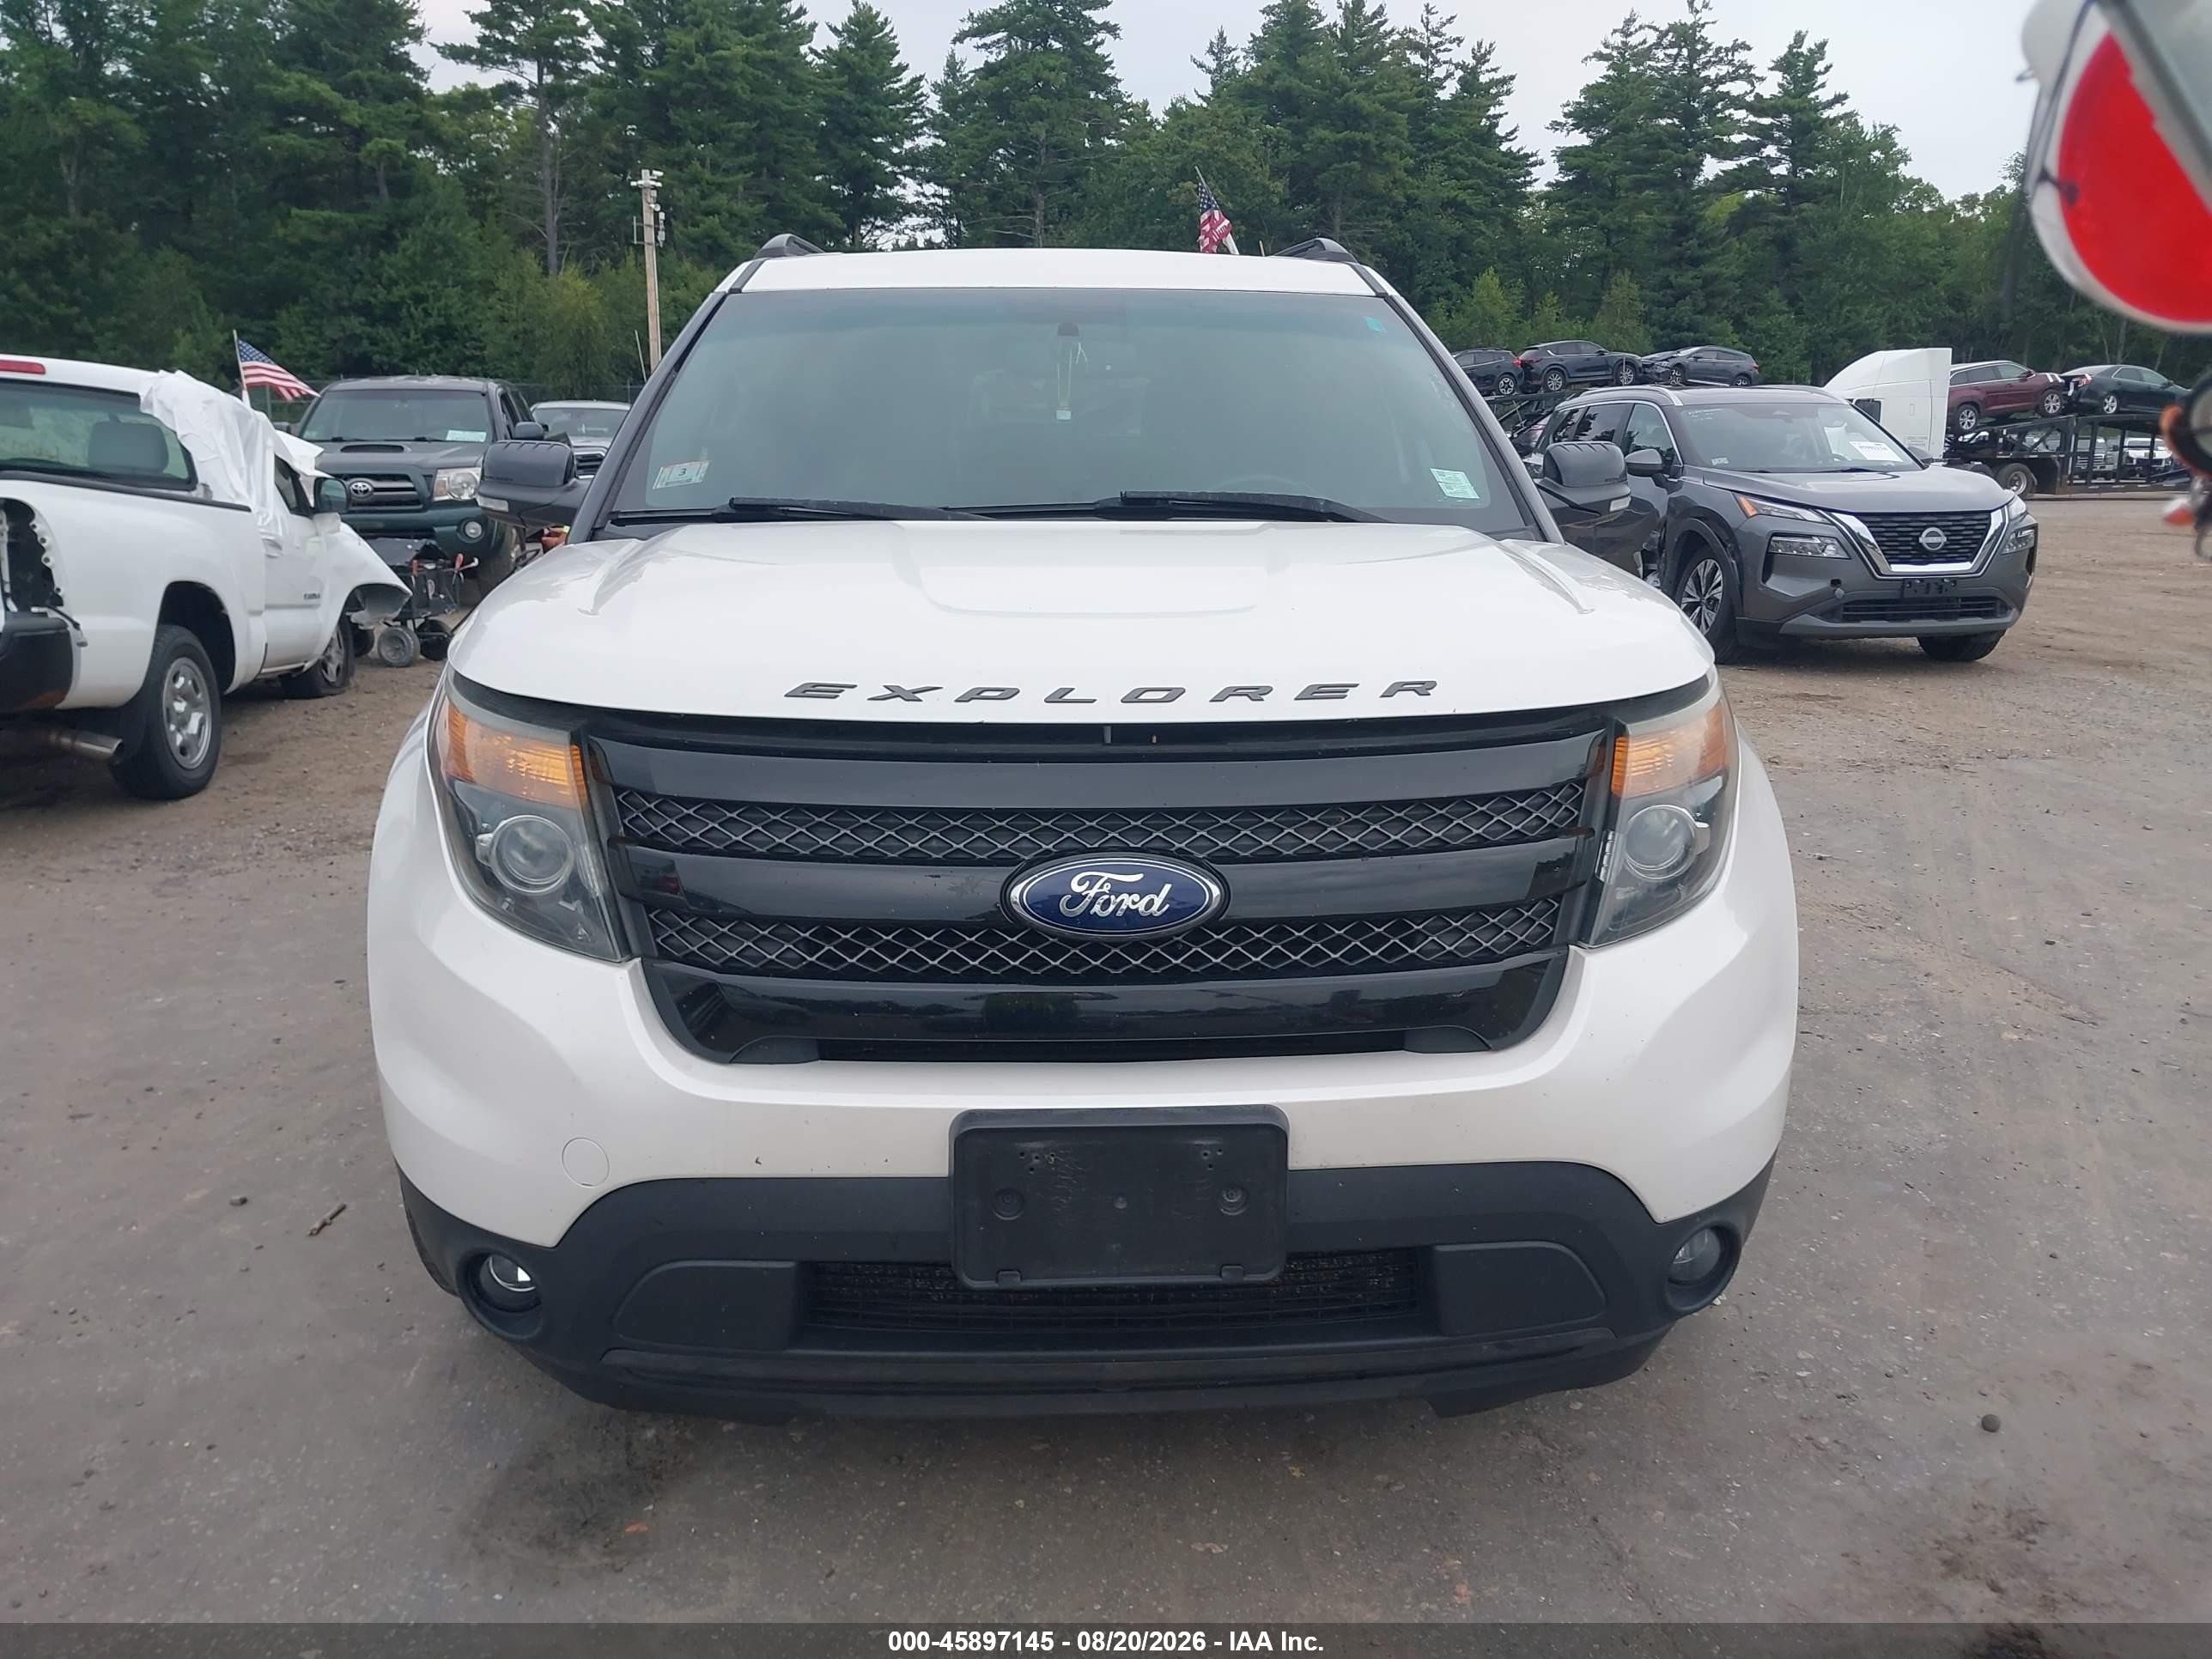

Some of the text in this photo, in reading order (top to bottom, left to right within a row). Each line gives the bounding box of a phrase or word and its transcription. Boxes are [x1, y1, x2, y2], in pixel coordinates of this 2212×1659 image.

[678, 468, 687, 477] 3
[783, 680, 1438, 704] EXPLORER
[1059, 871, 1172, 918] Ford
